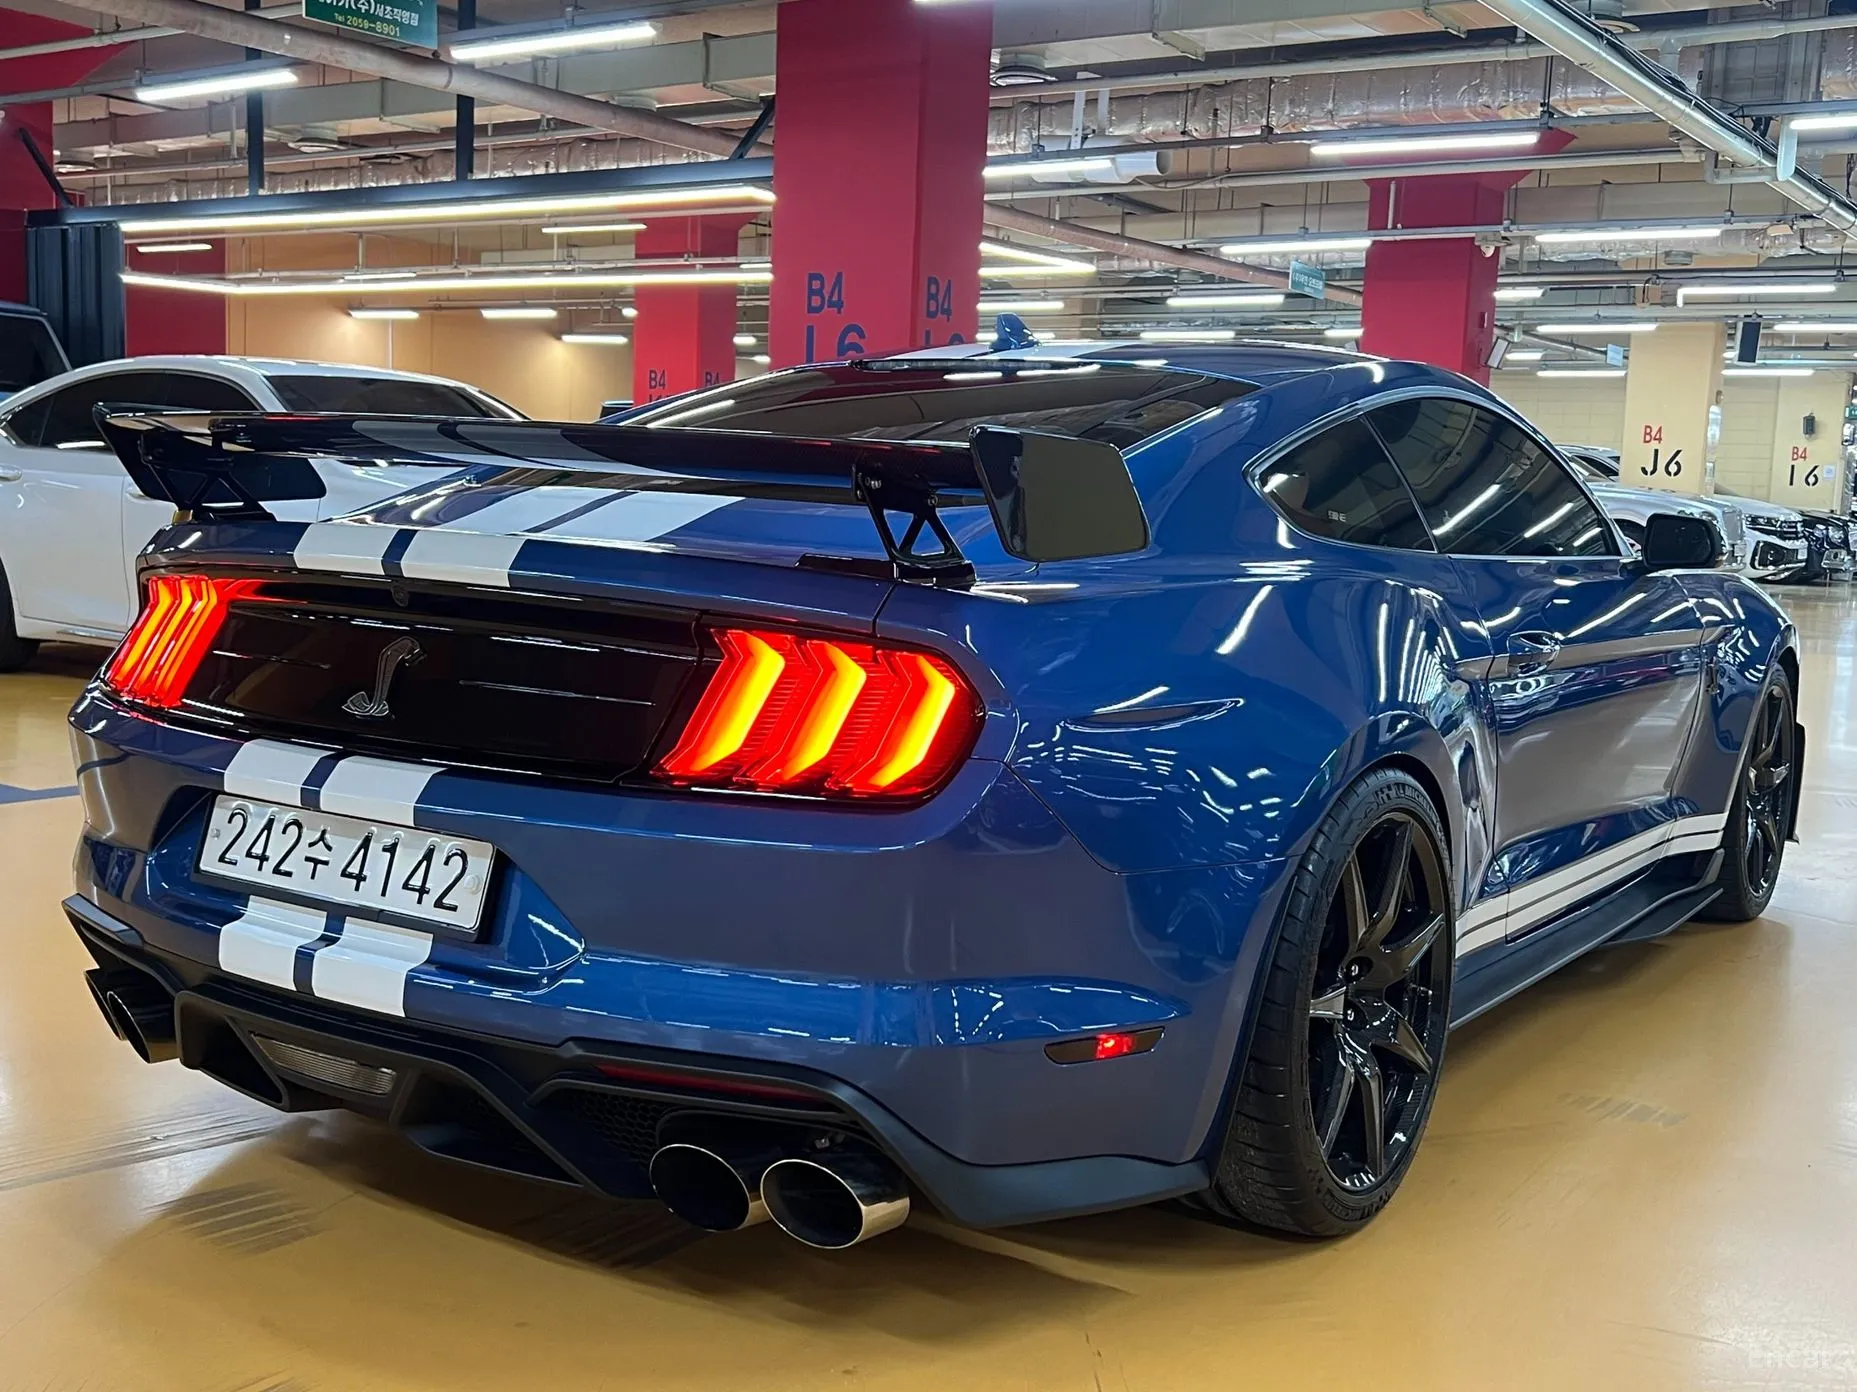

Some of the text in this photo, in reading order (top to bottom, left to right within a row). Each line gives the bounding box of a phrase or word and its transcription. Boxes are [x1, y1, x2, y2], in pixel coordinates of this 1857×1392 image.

[806, 271, 844, 315] B4
[926, 275, 953, 323] B4
[649, 369, 666, 390] B4
[1643, 425, 1663, 444] B4
[1640, 448, 1682, 477] J6
[1792, 446, 1808, 461] B4
[218, 807, 469, 912] 242수4142
